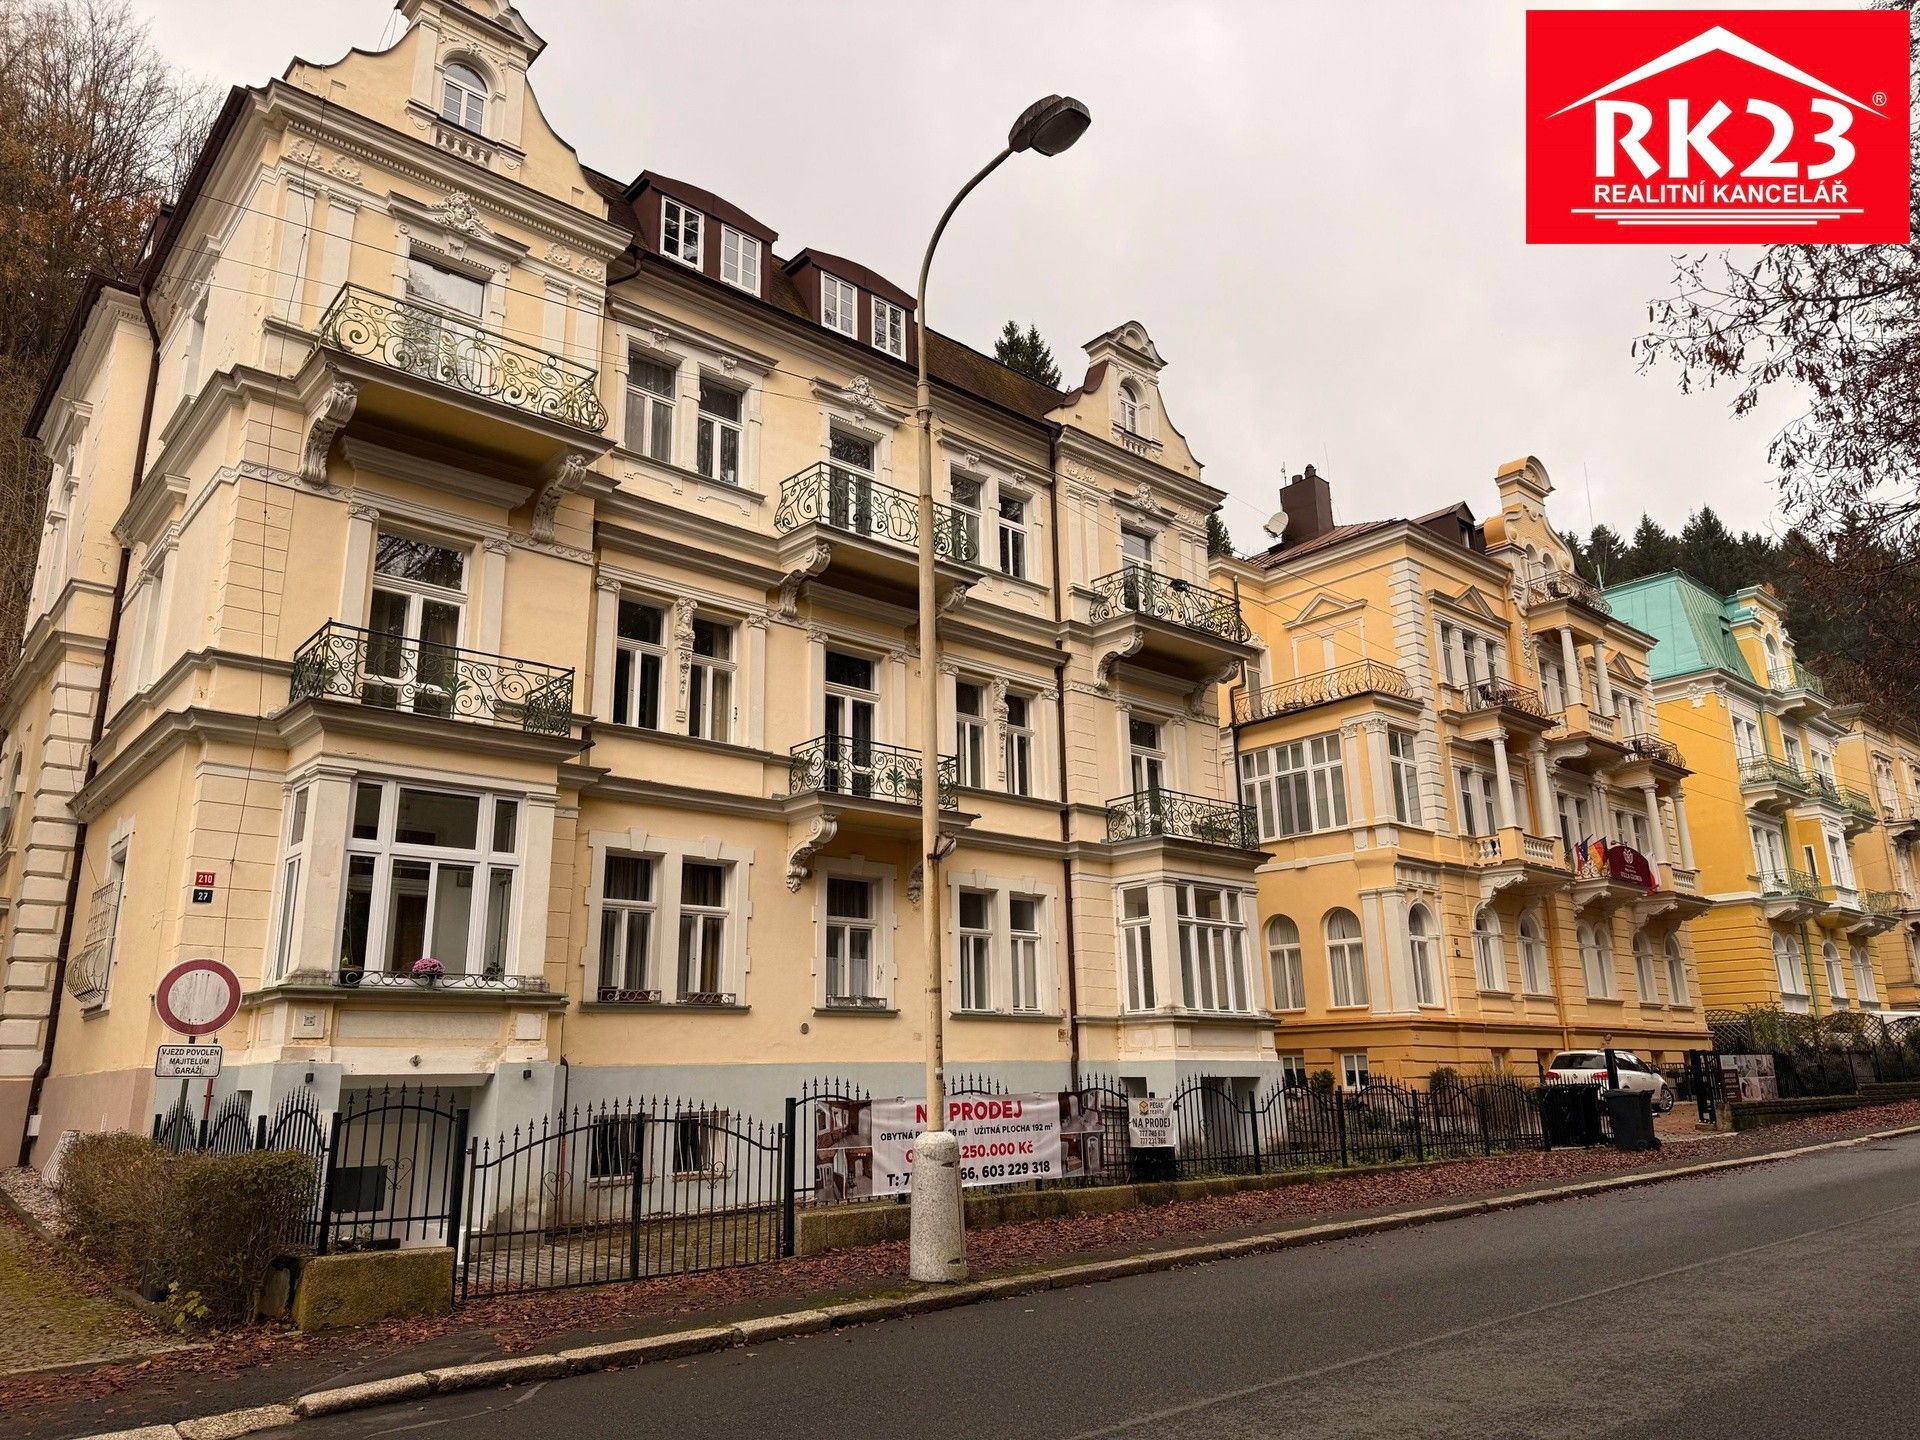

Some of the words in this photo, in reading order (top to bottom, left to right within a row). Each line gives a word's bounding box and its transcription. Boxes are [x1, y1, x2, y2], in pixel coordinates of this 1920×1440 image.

[198, 874, 213, 884] 210
[197, 892, 208, 901] 27
[161, 1048, 185, 1056] VJEZD
[186, 1048, 220, 1056] POVOLEN
[915, 1104, 928, 1124] N
[949, 1100, 1023, 1121] PRODEJ
[1132, 1118, 1143, 1128] NA
[1144, 1118, 1171, 1128] PRODEJ
[974, 1123, 1001, 1135] UŽITNÁ
[1001, 1124, 1031, 1133] PLOCHA
[1032, 1123, 1044, 1131] 192
[880, 1130, 914, 1141] OBYTNÁ
[959, 1142, 1016, 1159] .250.000
[1018, 1140, 1034, 1154] Kč
[960, 1166, 979, 1181] 66,
[981, 1163, 1005, 1178] 603
[1007, 1161, 1029, 1176] 229
[1031, 1160, 1051, 1174] 318
[886, 1173, 900, 1187] T:
